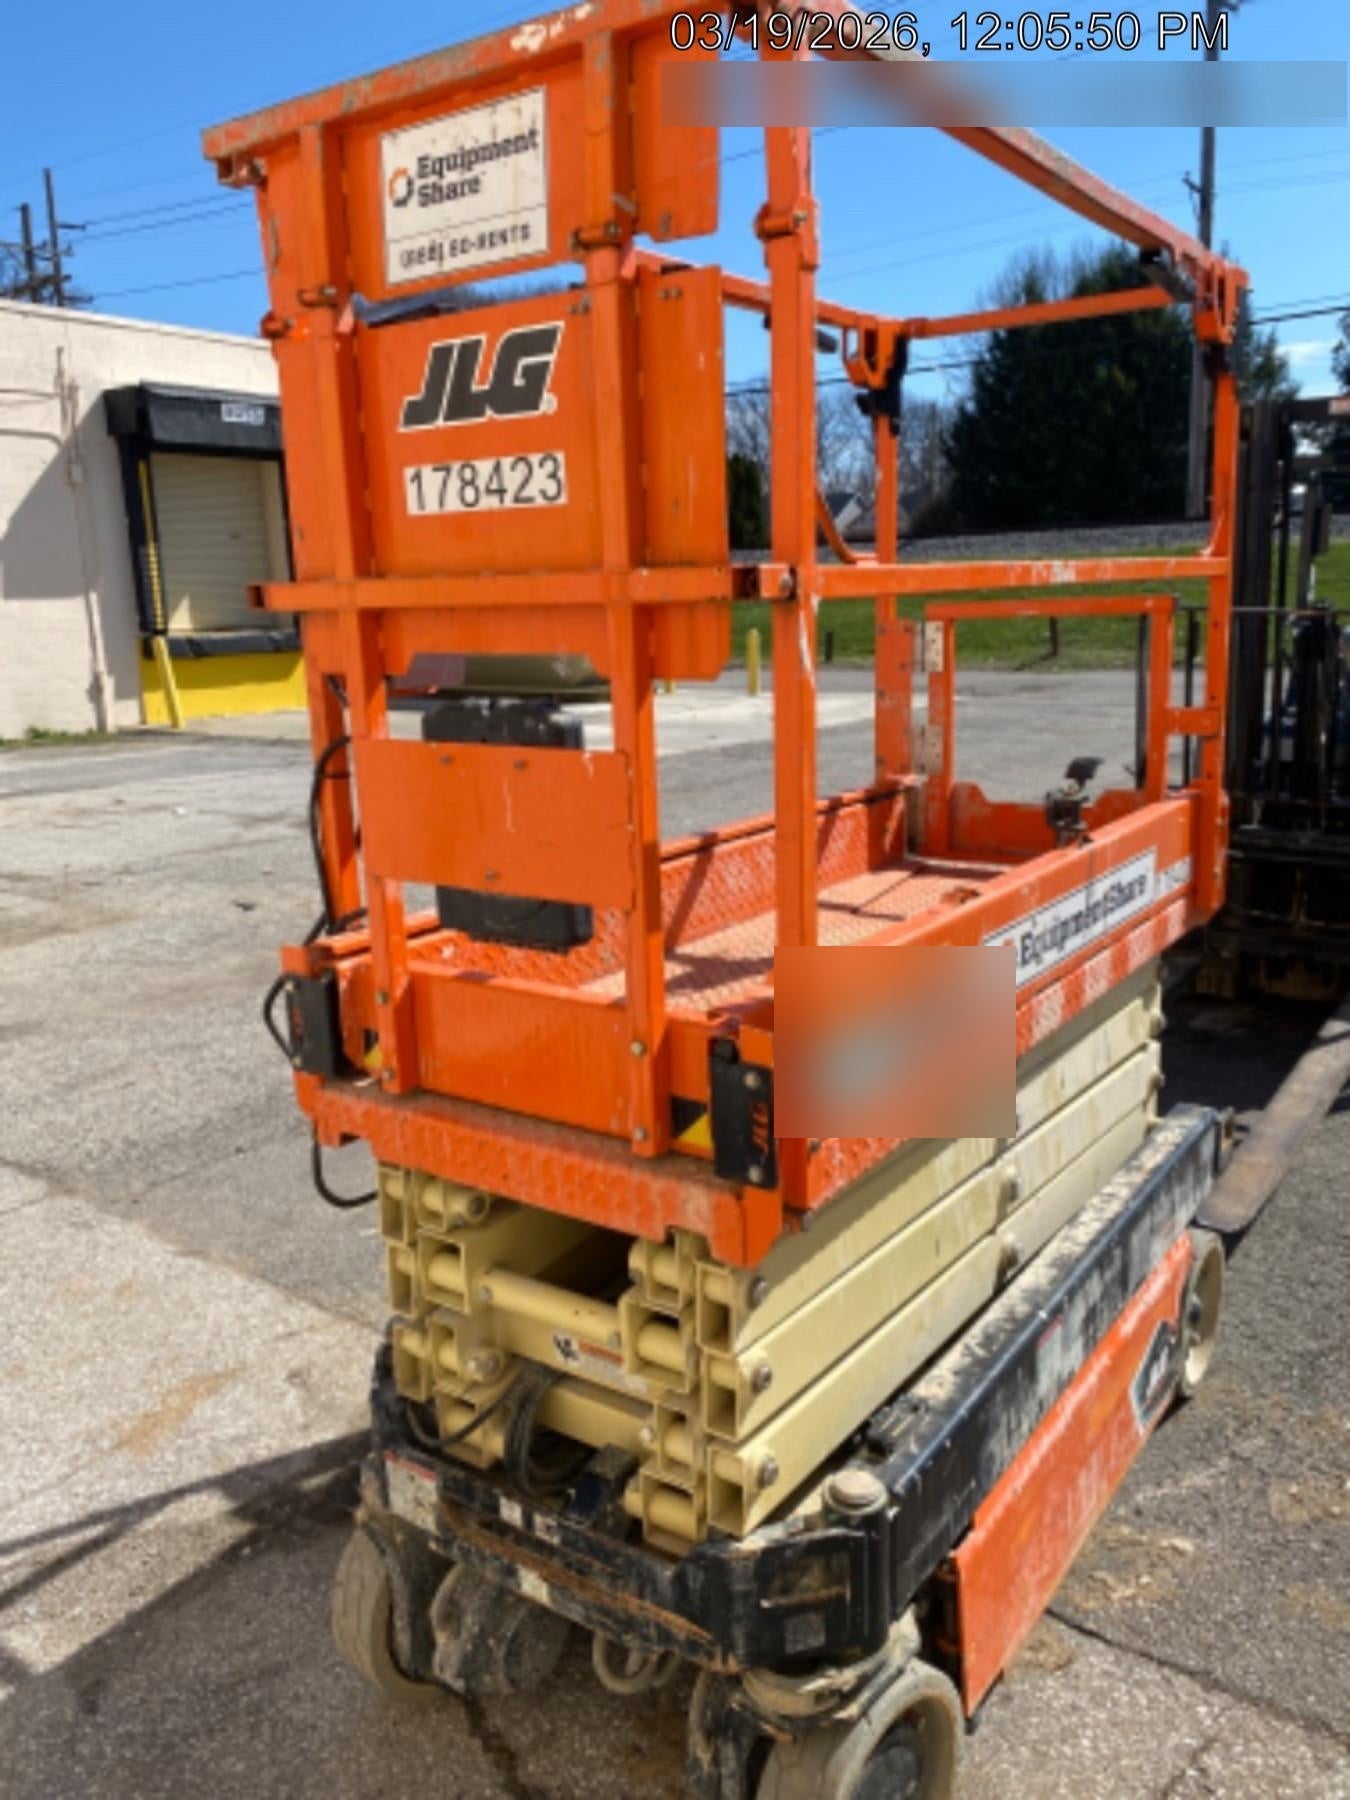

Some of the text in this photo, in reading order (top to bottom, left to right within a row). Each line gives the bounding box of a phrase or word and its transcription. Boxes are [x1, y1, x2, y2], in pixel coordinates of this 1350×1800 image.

[416, 127, 539, 179] Equipment
[417, 174, 482, 208] Share
[399, 321, 564, 432] JLG
[409, 453, 563, 511] 178423
